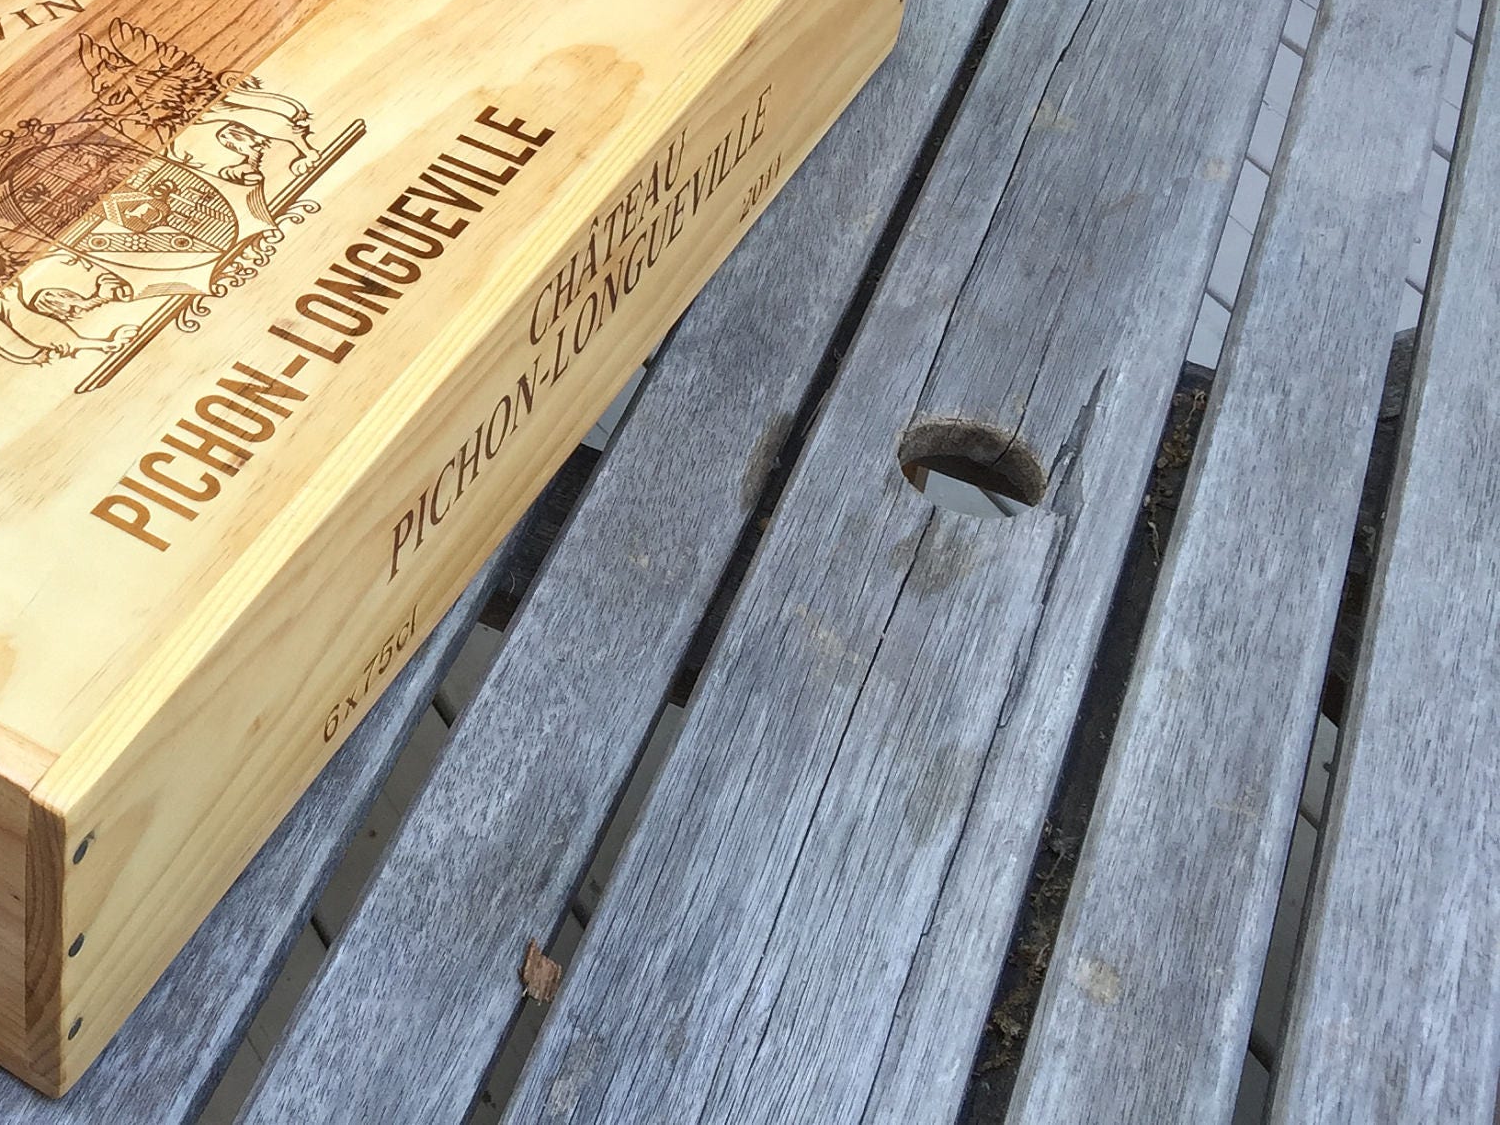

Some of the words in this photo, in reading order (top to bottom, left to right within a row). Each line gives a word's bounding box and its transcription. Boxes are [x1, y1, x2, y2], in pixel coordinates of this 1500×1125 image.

[529, 127, 688, 346] CHÂTEAU
[739, 150, 782, 223] 2011
[90, 105, 556, 552] PICHON-LONGUEVILLE
[387, 83, 772, 585] PICHON-LONGUEVILLE
[323, 603, 417, 743] 6x75cl
